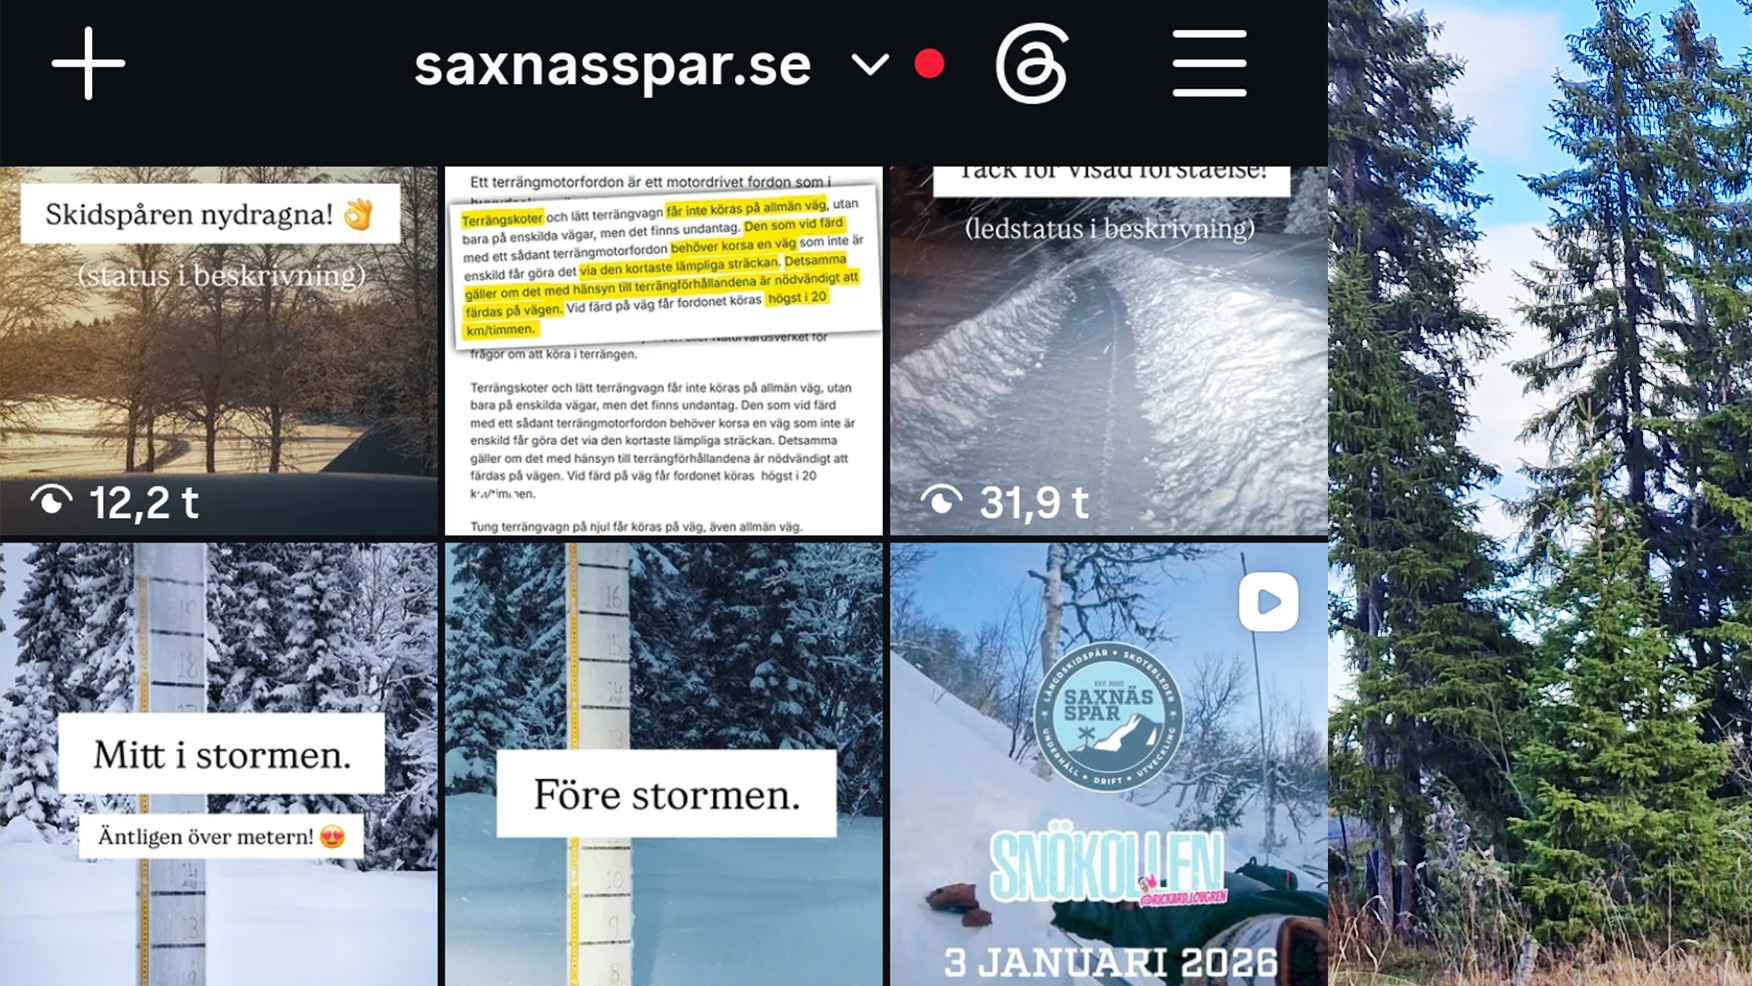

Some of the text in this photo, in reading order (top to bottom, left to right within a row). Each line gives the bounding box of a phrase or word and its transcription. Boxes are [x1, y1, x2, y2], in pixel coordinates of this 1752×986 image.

[414, 43, 811, 98] saxnasspar.se
[470, 175, 831, 190] Ett terrängmotorfordon är ett motordrivet fordon som i
[46, 203, 333, 231] Skidspåren nydragna!
[462, 199, 859, 229] Terrängskoter och lätt terrängvagn får inte köras på allmän väg, utan
[965, 217, 1255, 245] (ledstatus i beskrivning)
[78, 264, 365, 292] (status i beskrivning)
[464, 255, 848, 282] enskild får göra det via den kortaste lämpliga sträckan. Detsamma
[467, 323, 536, 338] km/timmen.
[470, 453, 502, 466] gäller
[525, 454, 543, 463] det
[547, 453, 571, 463] med
[574, 453, 615, 466] hänsyn
[618, 453, 631, 463] till
[633, 453, 751, 466] terrängförhållandena
[753, 454, 765, 463] är
[768, 453, 831, 466] nödvändigt
[834, 455, 849, 463] att
[90, 485, 199, 525] 12,2 t
[980, 485, 1089, 525] 31,9 t
[606, 585, 622, 609] 16
[1123, 651, 1175, 703] SKOTERLEDER
[1064, 685, 1153, 705] SAXNÄS
[1064, 701, 1121, 721] SPÅR
[93, 739, 352, 770] Mitt i stormen.
[1042, 727, 1176, 785] UNDERHÅLL DRIFT UTVECKLING
[534, 778, 800, 811] Före stormen.
[98, 823, 314, 849] Äntligen över metern!
[991, 820, 1223, 902] SNÖKOLLEN
[611, 963, 620, 983] 8
[944, 947, 1278, 978] 3 JANUARI 2026
